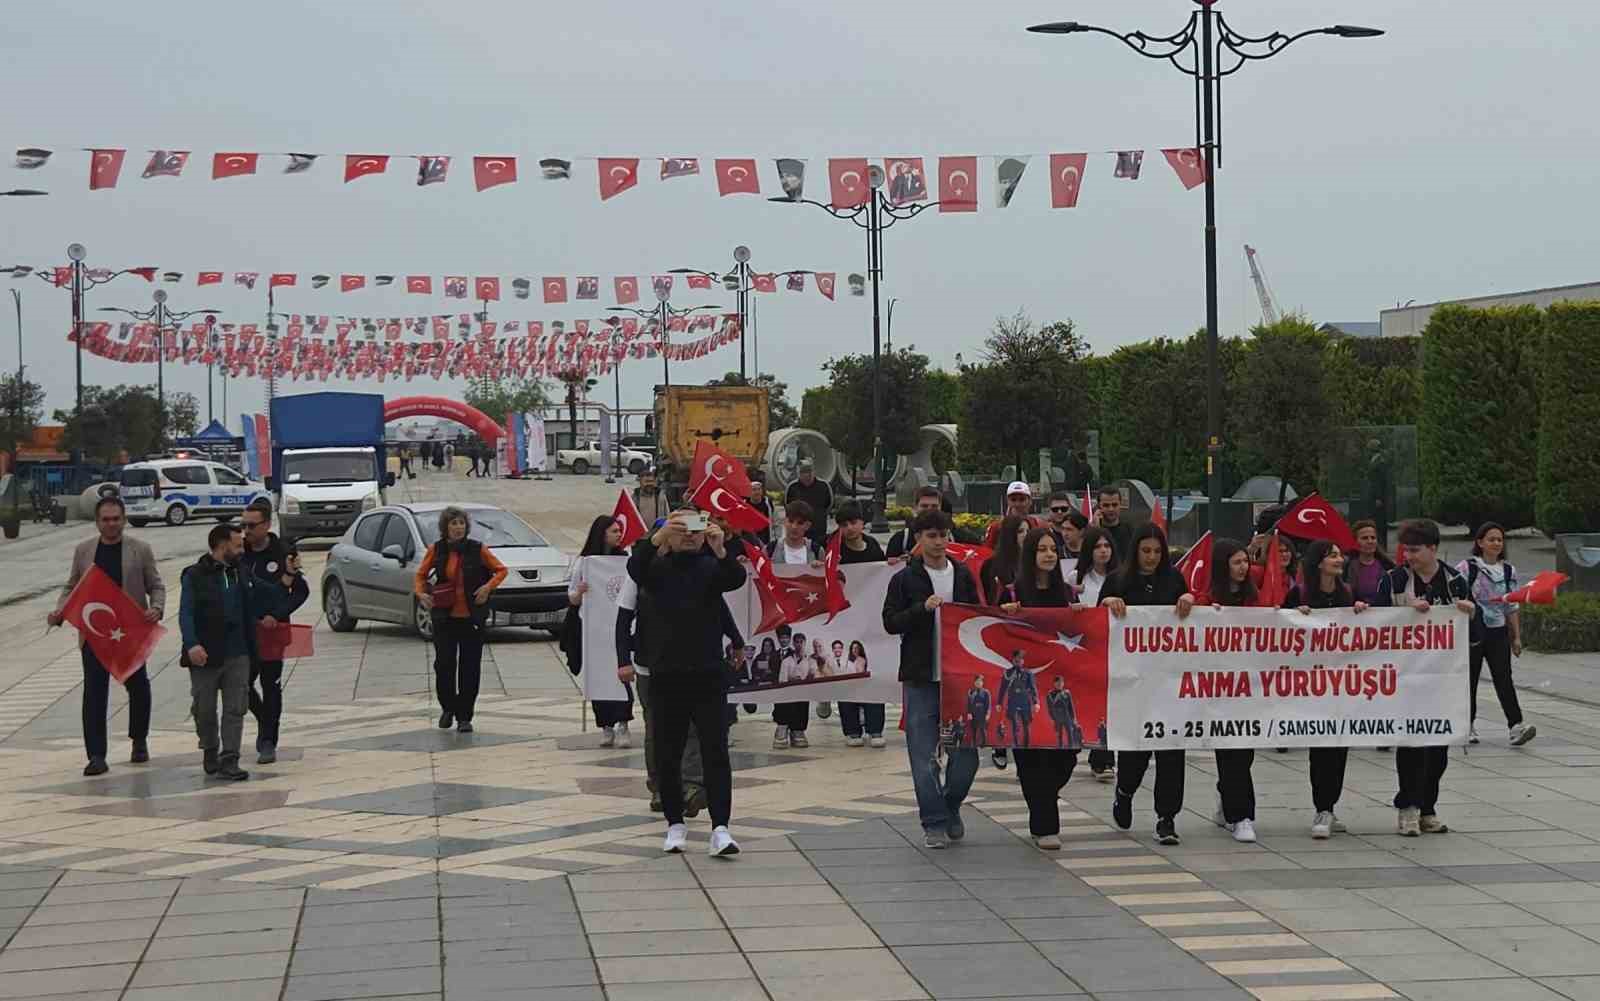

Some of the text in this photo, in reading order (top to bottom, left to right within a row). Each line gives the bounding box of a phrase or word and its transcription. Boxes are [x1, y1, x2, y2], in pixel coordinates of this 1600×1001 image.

[1124, 618, 1455, 656] ULUSAL KURTULUŞ MÜCADELESİNİ
[1178, 664, 1398, 701] ANMA YÜRÜYÜŞÜ
[1144, 721, 1165, 739] 23
[1184, 721, 1204, 738] 25
[1210, 720, 1261, 737] MAYIS
[1279, 719, 1337, 736] SAMSUN
[1350, 719, 1394, 736] KAVAK
[1407, 719, 1454, 735] HAVZA
